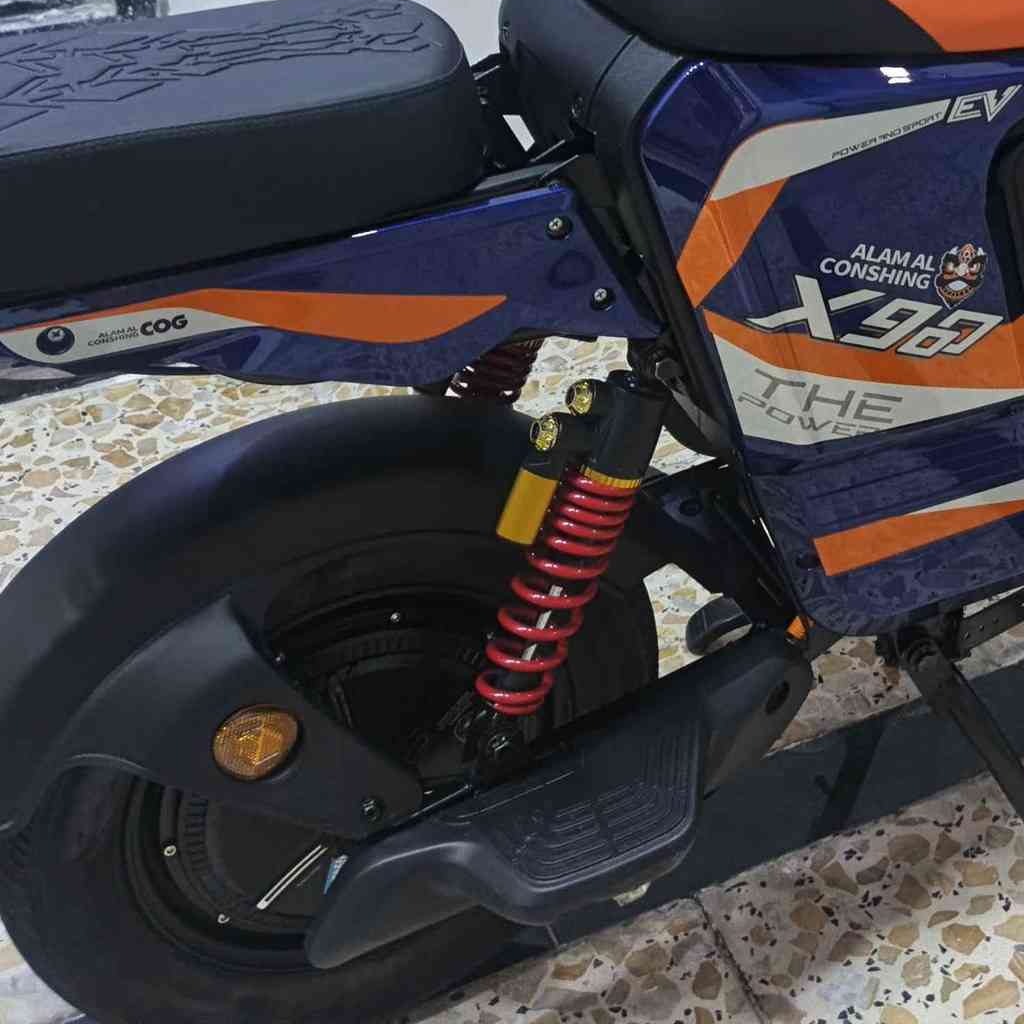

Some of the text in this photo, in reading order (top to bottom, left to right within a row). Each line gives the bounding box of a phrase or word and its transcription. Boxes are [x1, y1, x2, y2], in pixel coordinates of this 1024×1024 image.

[947, 84, 1022, 123] EV
[818, 256, 931, 290] CONSHING
[850, 243, 936, 272] ALAM AL
[140, 314, 188, 336] COG
[754, 367, 903, 425] THE
